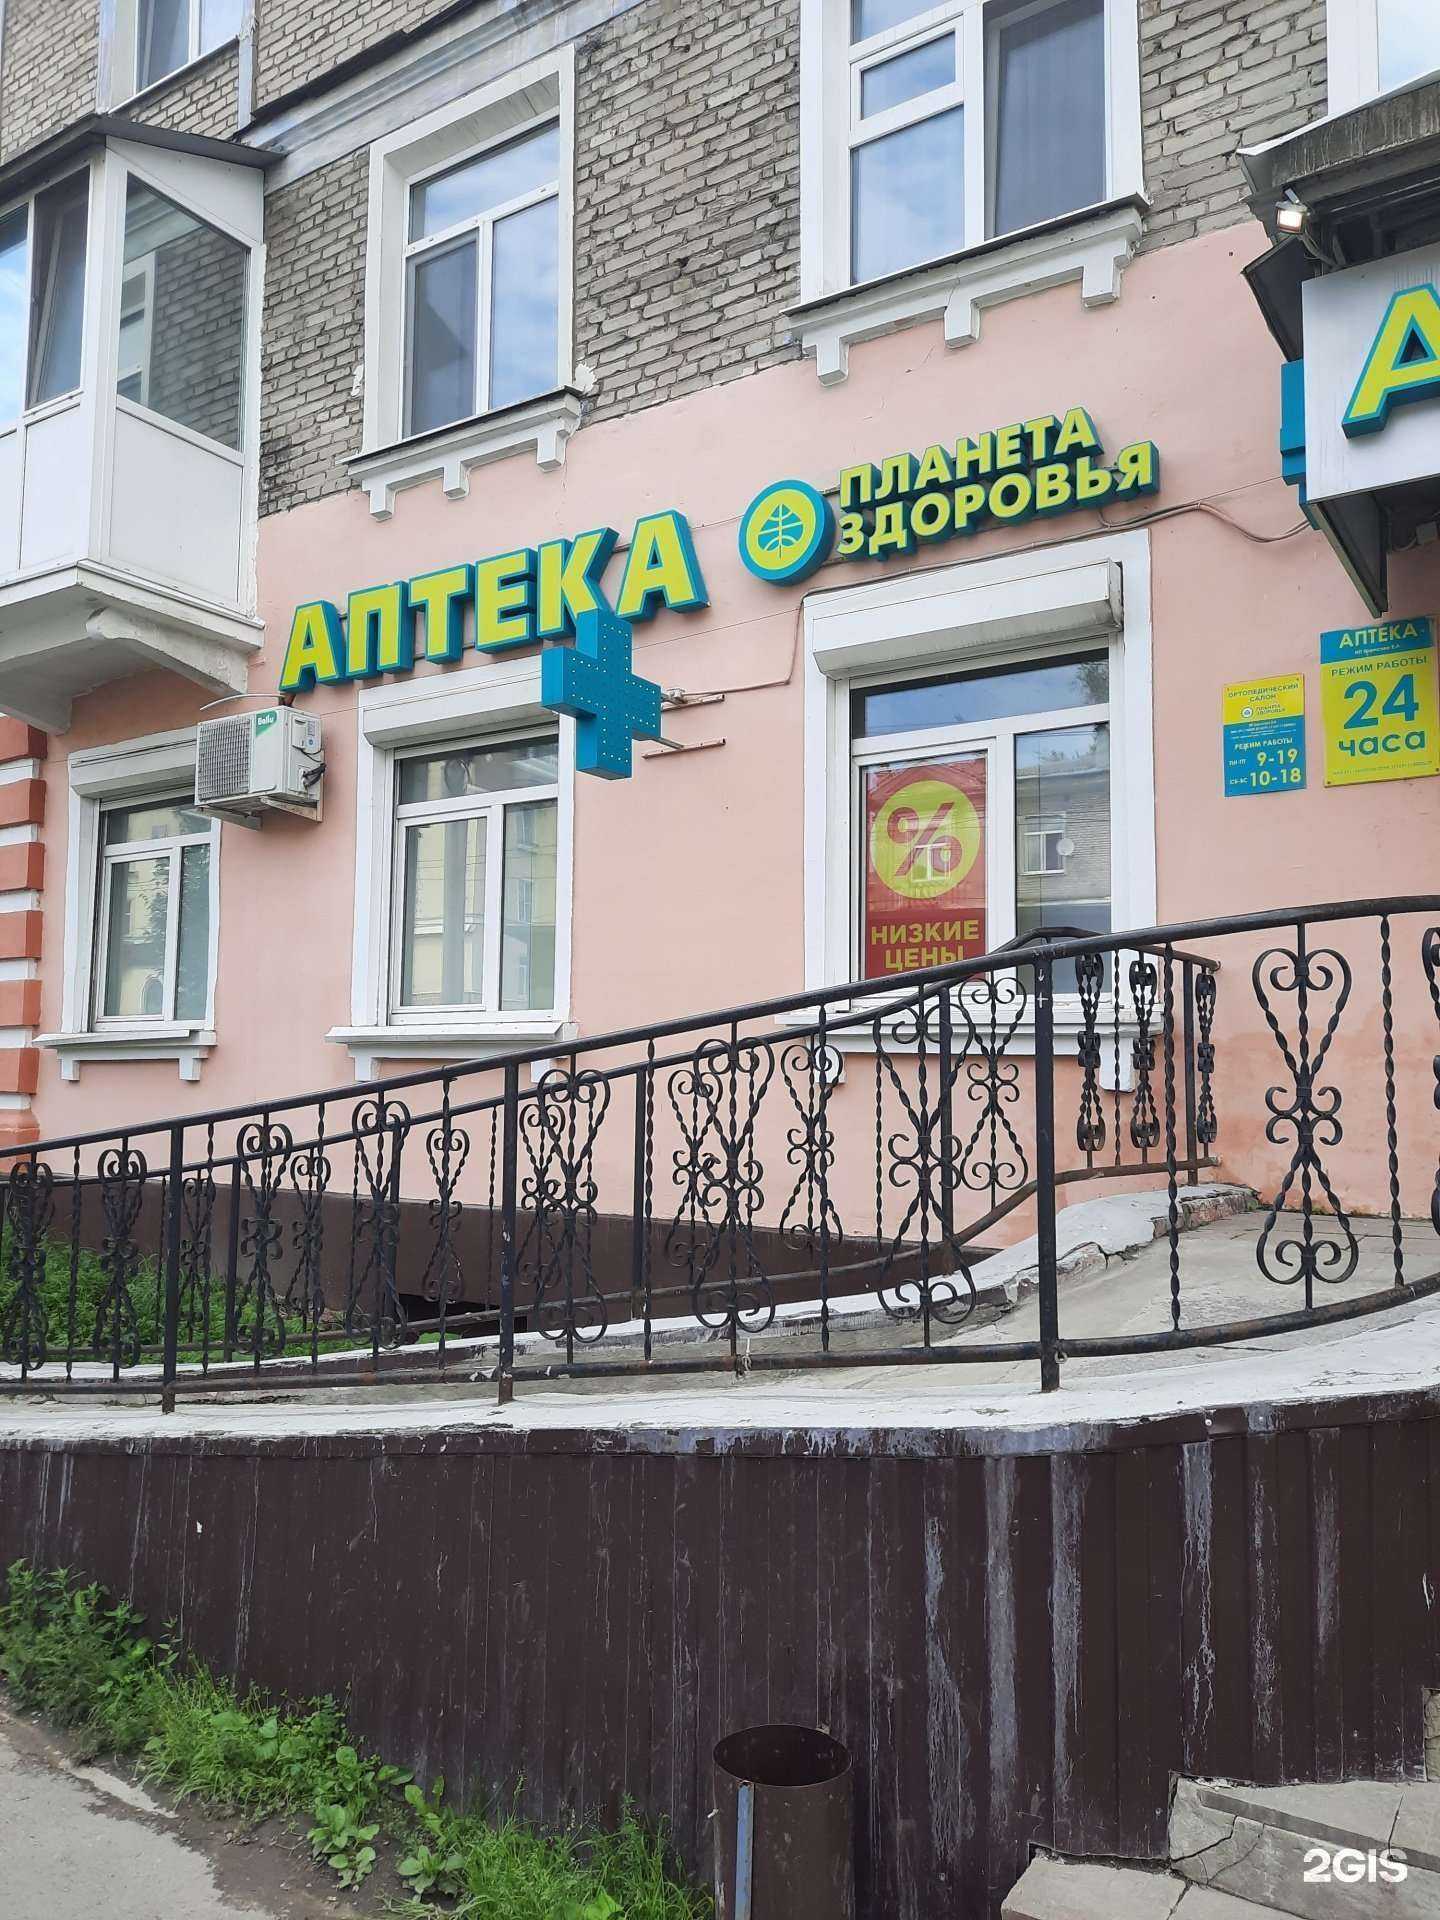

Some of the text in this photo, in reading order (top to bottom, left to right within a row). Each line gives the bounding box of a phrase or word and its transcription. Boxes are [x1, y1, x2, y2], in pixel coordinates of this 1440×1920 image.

[838, 406, 1104, 508] ПЛАНЕТА
[837, 440, 1160, 556] ЗДОРОВЬЯ
[279, 509, 709, 693] АПТЕКА
[1339, 623, 1418, 649] АПТЕКА
[1331, 655, 1428, 677] РЕЖИМ РАБОТЫ
[1228, 683, 1299, 698] ОРТОПЕДИЧЕСКИЙ
[1249, 693, 1276, 703] САЛОН
[1343, 673, 1419, 730] 24
[1234, 737, 1293, 751] РЕЖИМ РАБОТЫ
[1257, 748, 1298, 767] 9-19
[1250, 768, 1301, 787] 10-18
[871, 919, 980, 946] НИЗКИЕ
[885, 944, 965, 971] ЦЕНЫ
